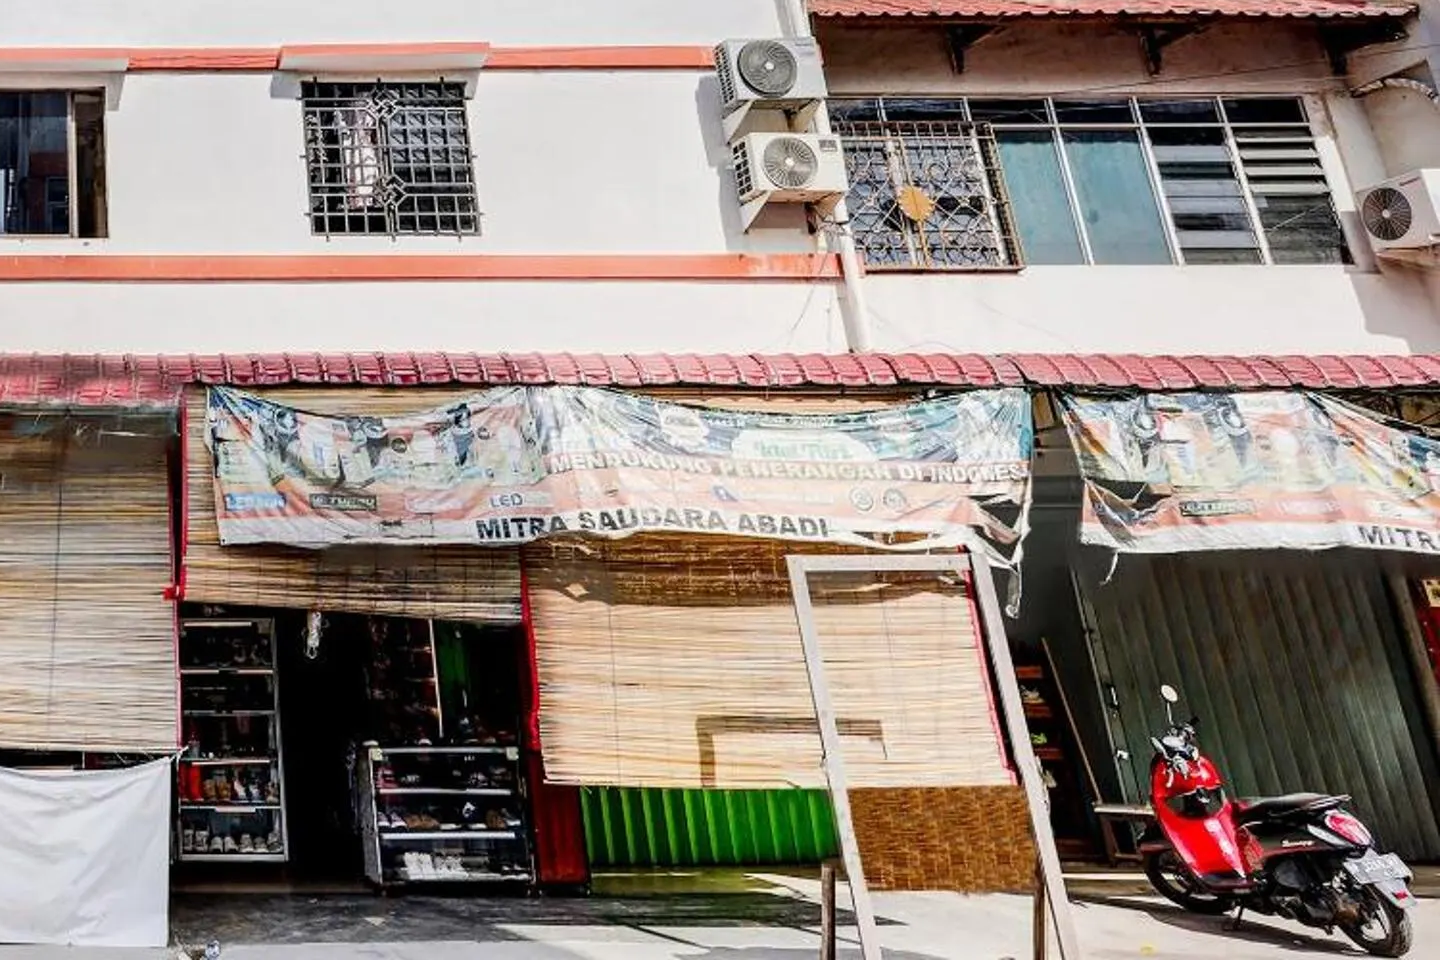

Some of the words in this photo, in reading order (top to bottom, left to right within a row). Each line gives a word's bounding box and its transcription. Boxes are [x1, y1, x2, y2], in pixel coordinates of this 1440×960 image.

[550, 450, 712, 474] MENDUKUNG
[720, 459, 892, 480] PENERANGAN
[898, 461, 924, 481] DI
[475, 515, 569, 540] MITRA
[578, 507, 729, 532] SAUDARA
[737, 513, 829, 538] ABADI
[1358, 525, 1440, 550] MITR
